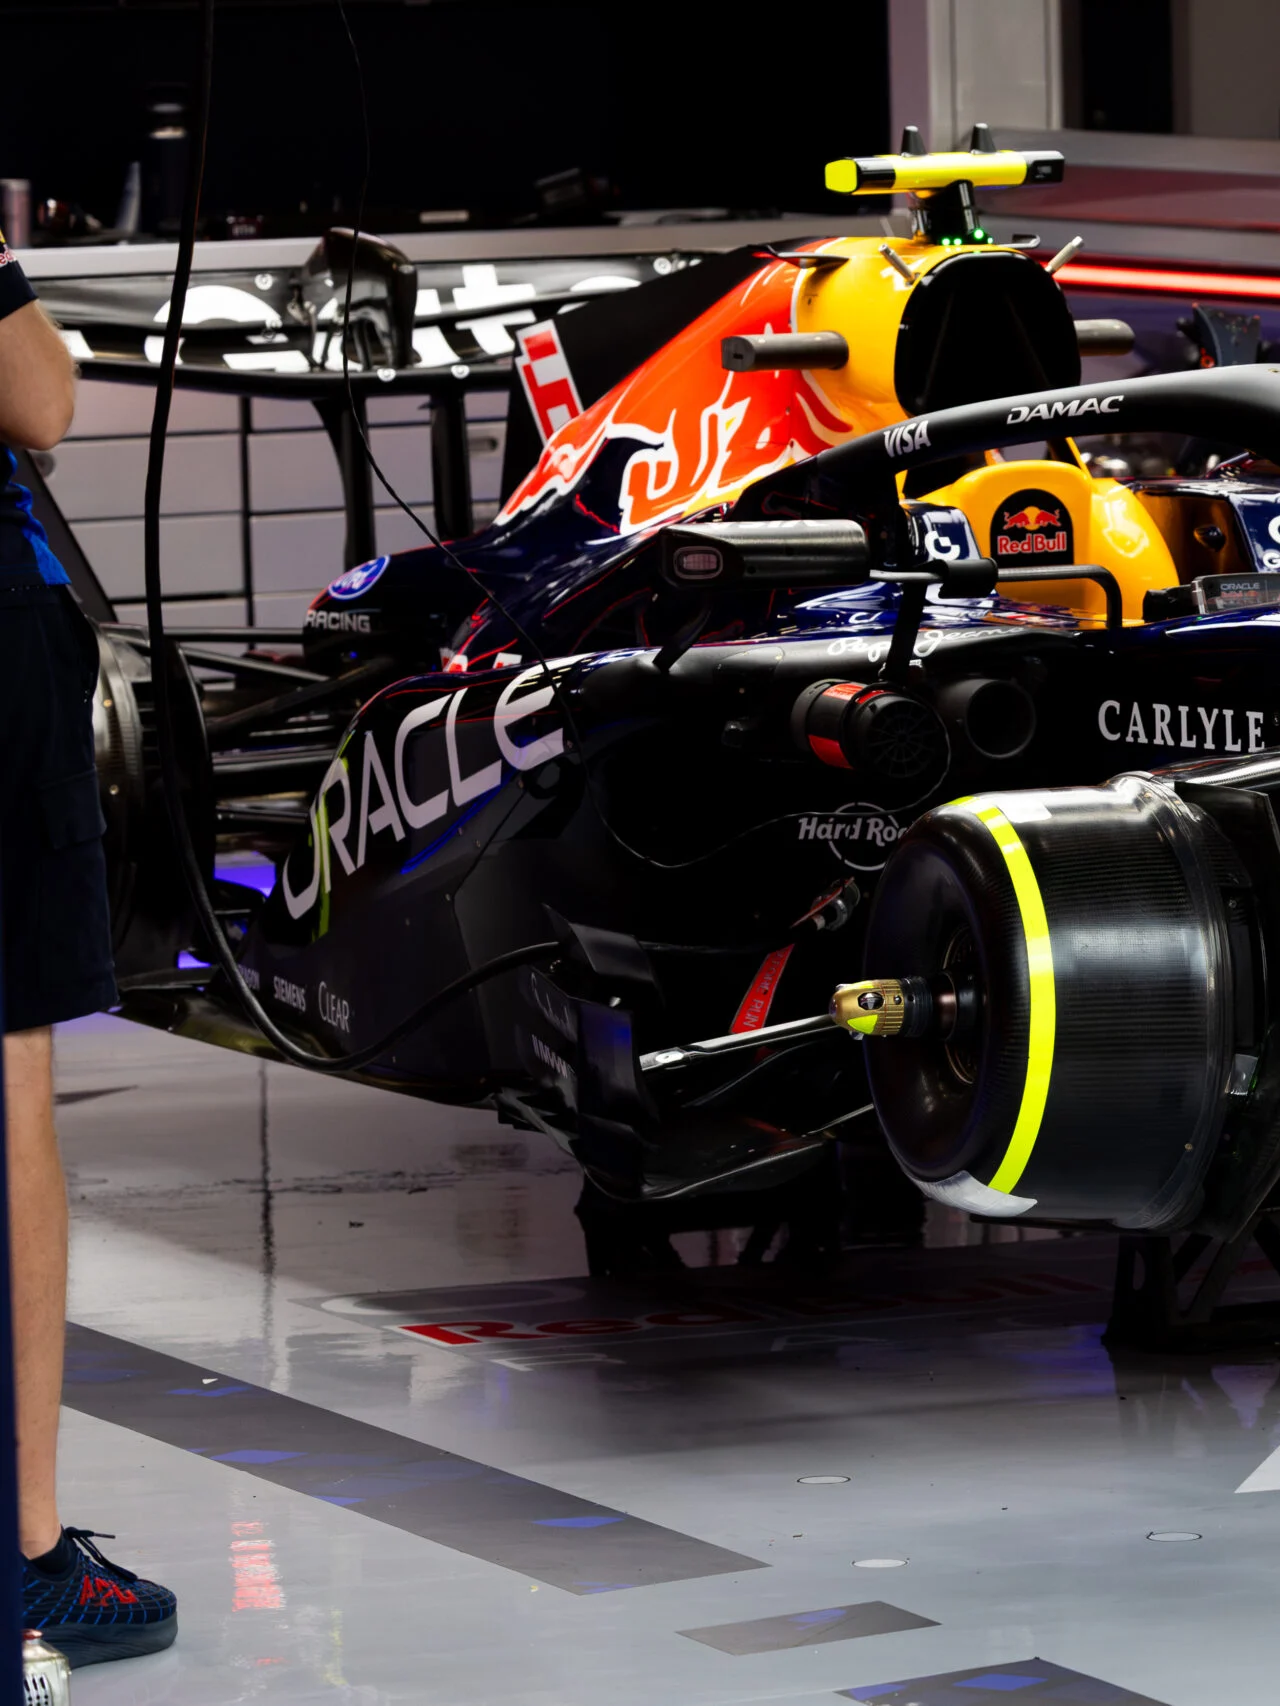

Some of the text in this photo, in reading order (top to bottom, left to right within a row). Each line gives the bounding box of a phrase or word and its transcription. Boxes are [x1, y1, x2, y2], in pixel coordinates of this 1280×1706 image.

[883, 395, 1124, 458] VISA DAMAC
[1220, 582, 1260, 591] ORACLE
[304, 609, 371, 633] RACING
[1098, 699, 1265, 752] CARLYLE
[282, 654, 584, 919] ORACLE
[798, 816, 861, 840] Hard
[273, 975, 306, 1012] SIEMENS
